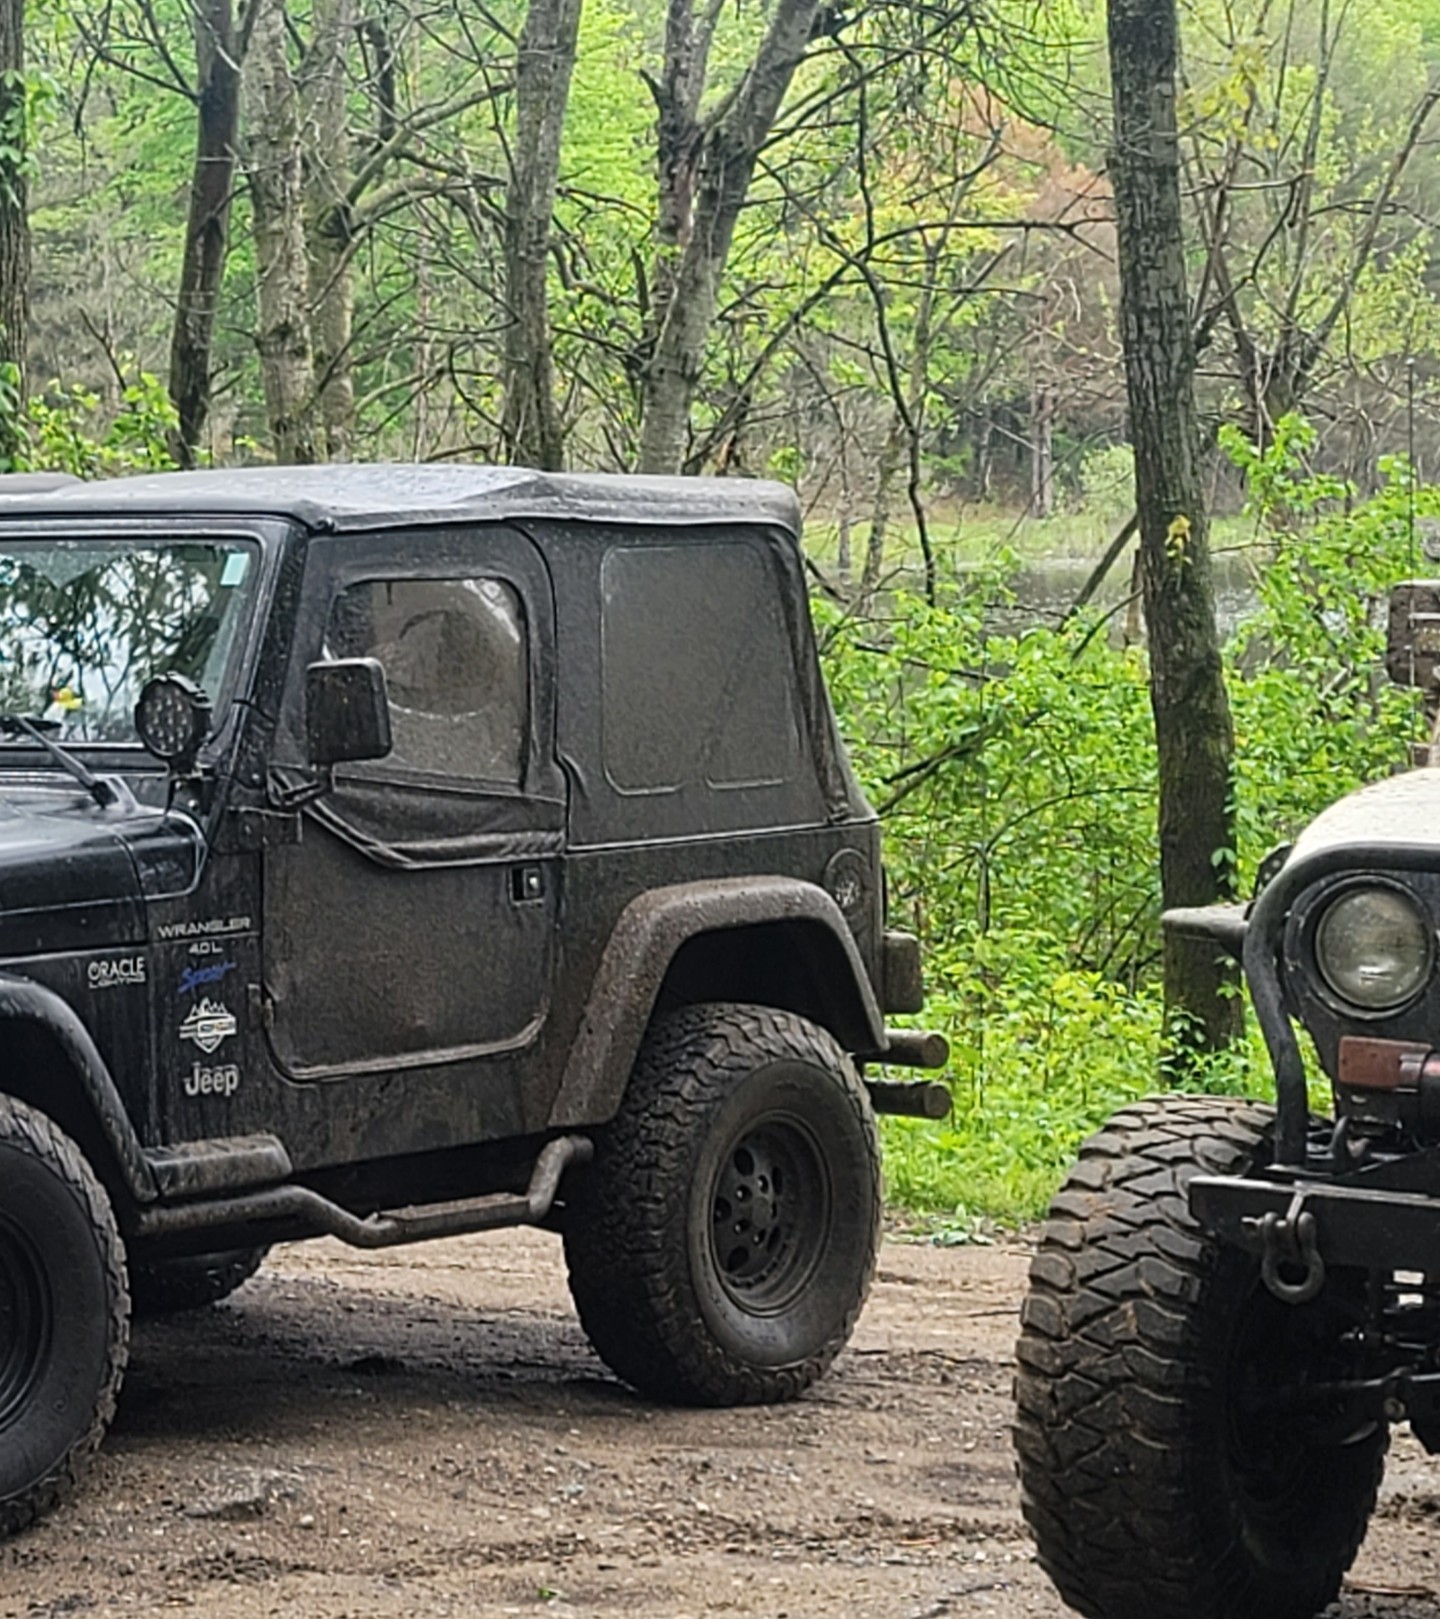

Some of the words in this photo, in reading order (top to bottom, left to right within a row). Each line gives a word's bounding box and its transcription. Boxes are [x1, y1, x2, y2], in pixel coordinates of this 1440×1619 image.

[157, 917, 251, 939] WRANGLER
[87, 956, 145, 981] ORACLE
[182, 1060, 239, 1097] Jeep
